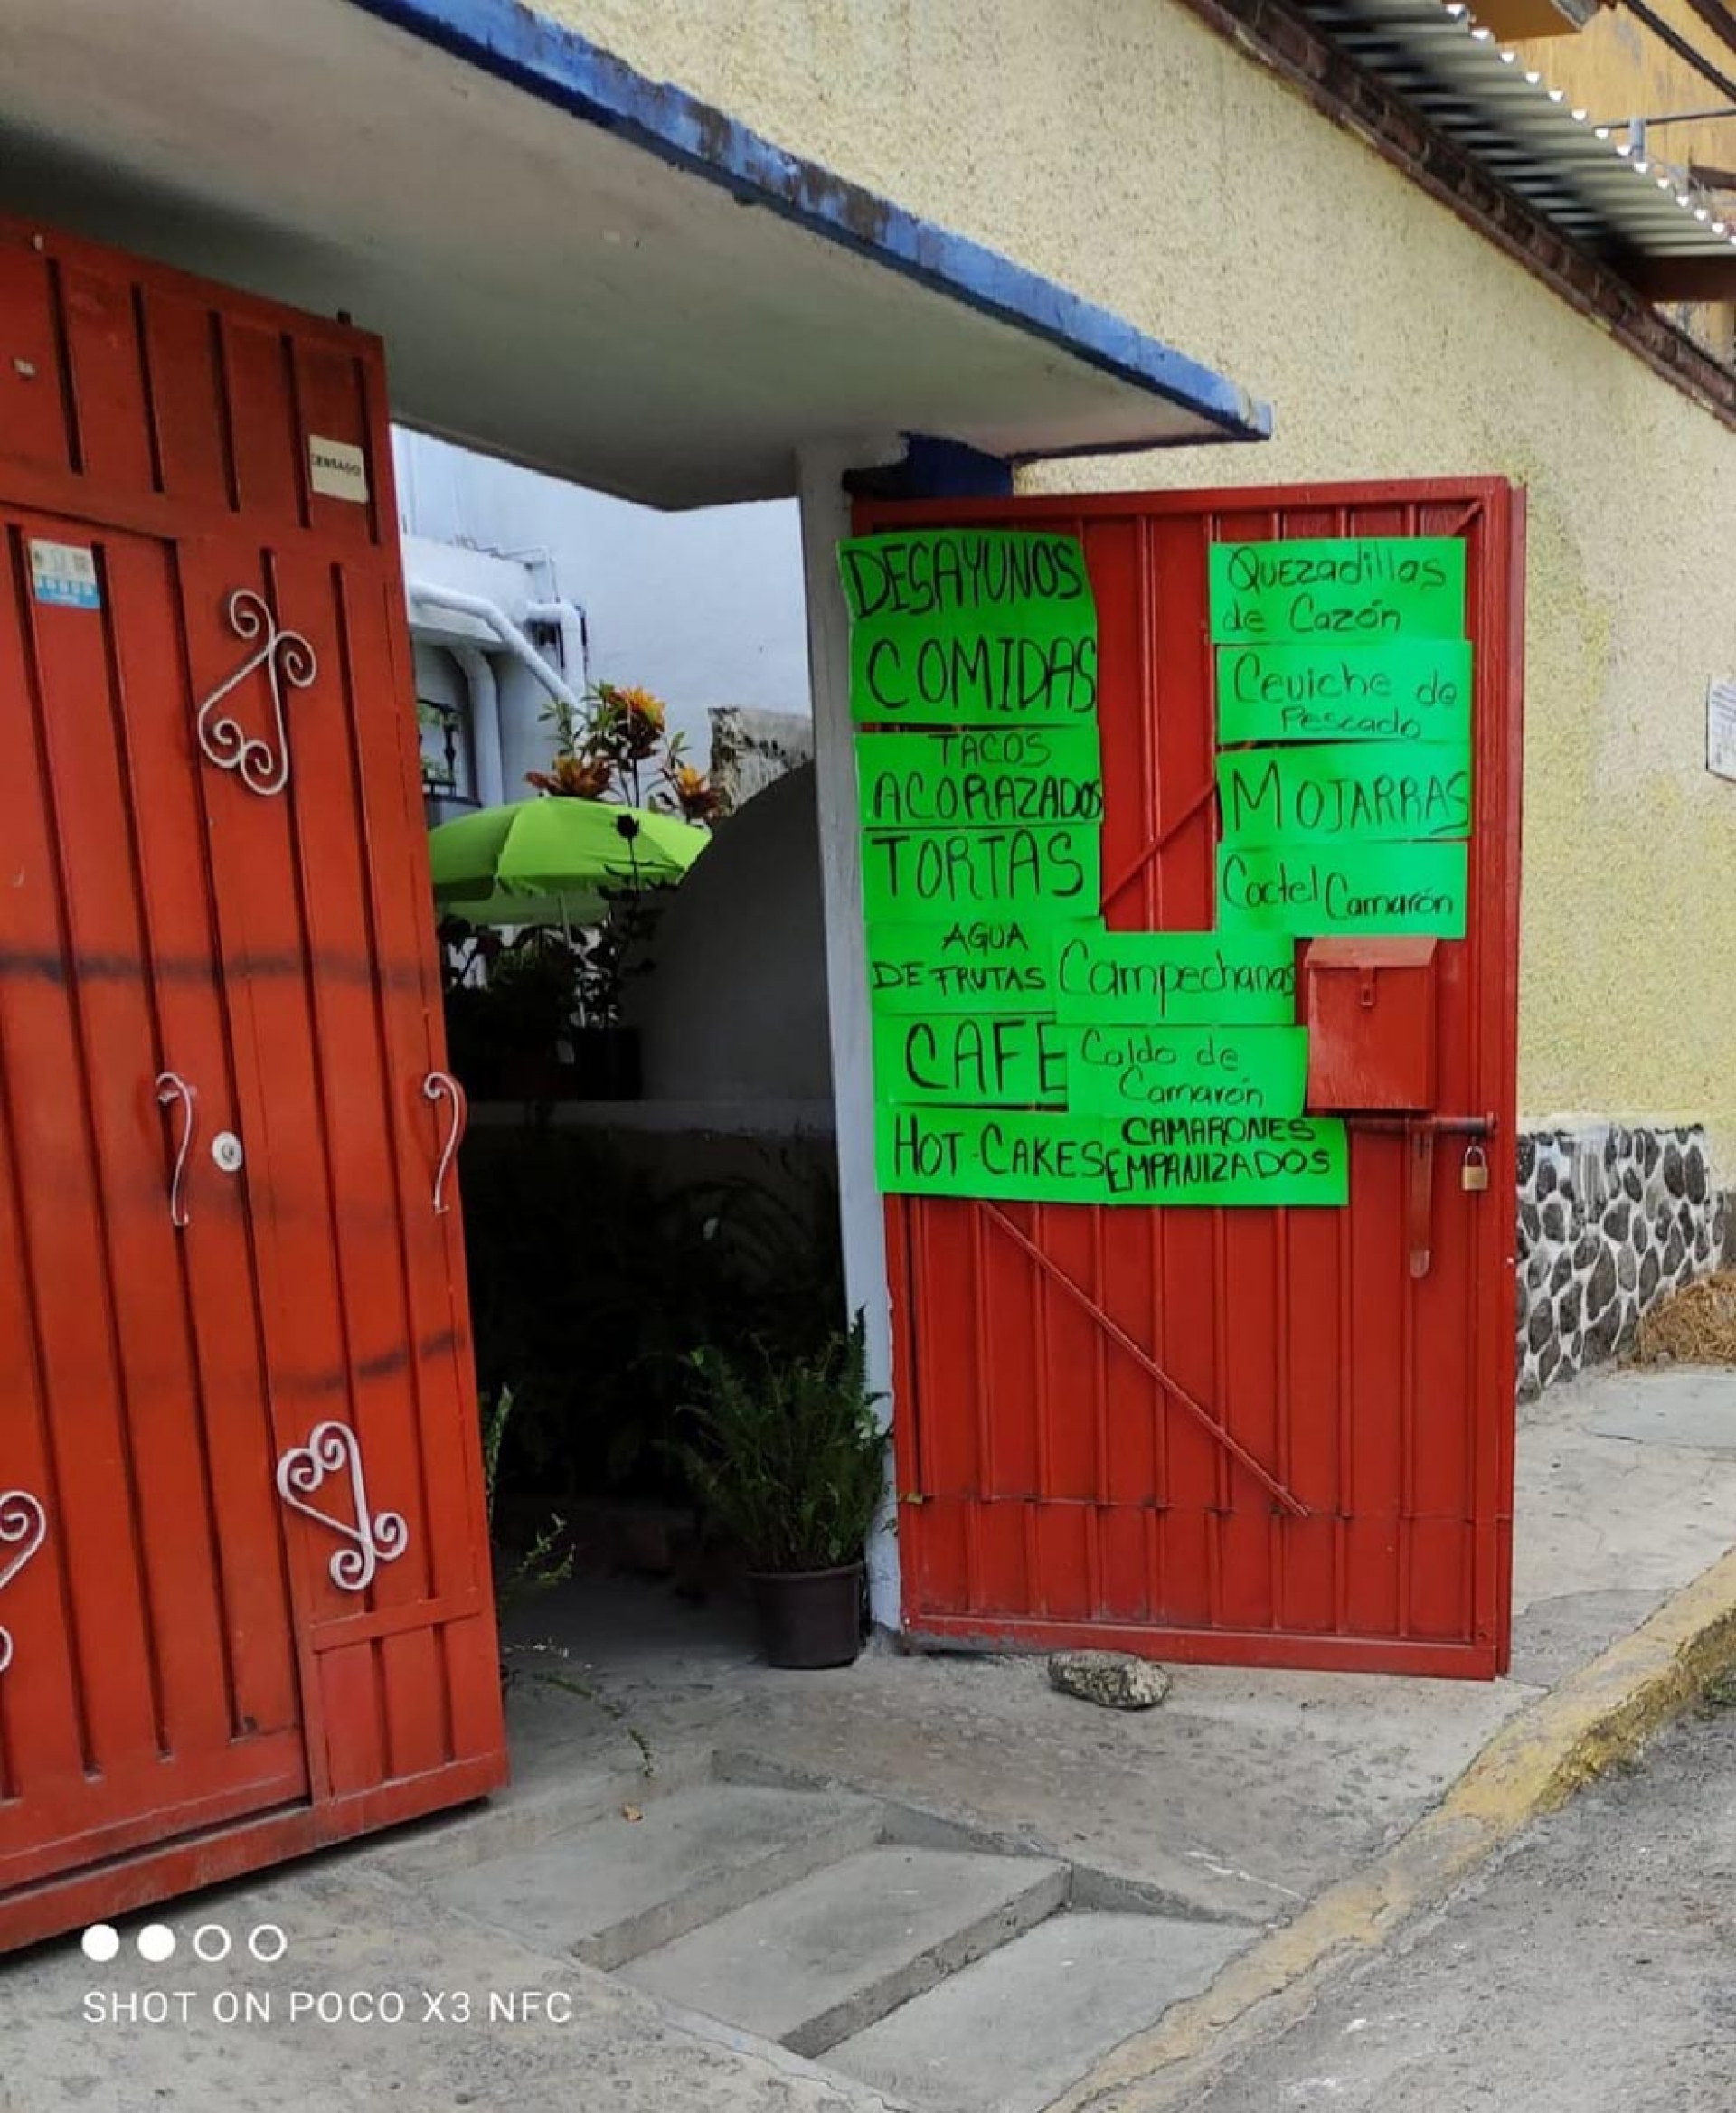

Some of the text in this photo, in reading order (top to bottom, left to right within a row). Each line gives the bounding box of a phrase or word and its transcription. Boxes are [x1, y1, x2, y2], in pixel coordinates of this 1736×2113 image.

[843, 537, 1082, 619] DESAYUNOS
[1222, 592, 1401, 632] de Cazón
[867, 634, 1097, 713] COMIDAS
[1234, 652, 1458, 706] Ceviche de
[1281, 704, 1421, 740] Pescado
[928, 732, 1051, 768] TACOS
[873, 772, 1102, 823] ACORAZADOS
[1232, 760, 1469, 835] MOJARRAS
[872, 828, 1083, 901] TORTAS
[1326, 872, 1453, 920] Camarón
[942, 921, 1029, 956] AGUA
[873, 961, 1046, 995] DE FRUTAS
[1059, 938, 1296, 1018] Campechanas
[906, 1019, 1067, 1093] CAFE
[1196, 1033, 1239, 1071] de
[1119, 1064, 1264, 1108] Camarón
[1121, 1116, 1316, 1146] CAMARONES
[1105, 1148, 1331, 1193] EMPANIZADOS
